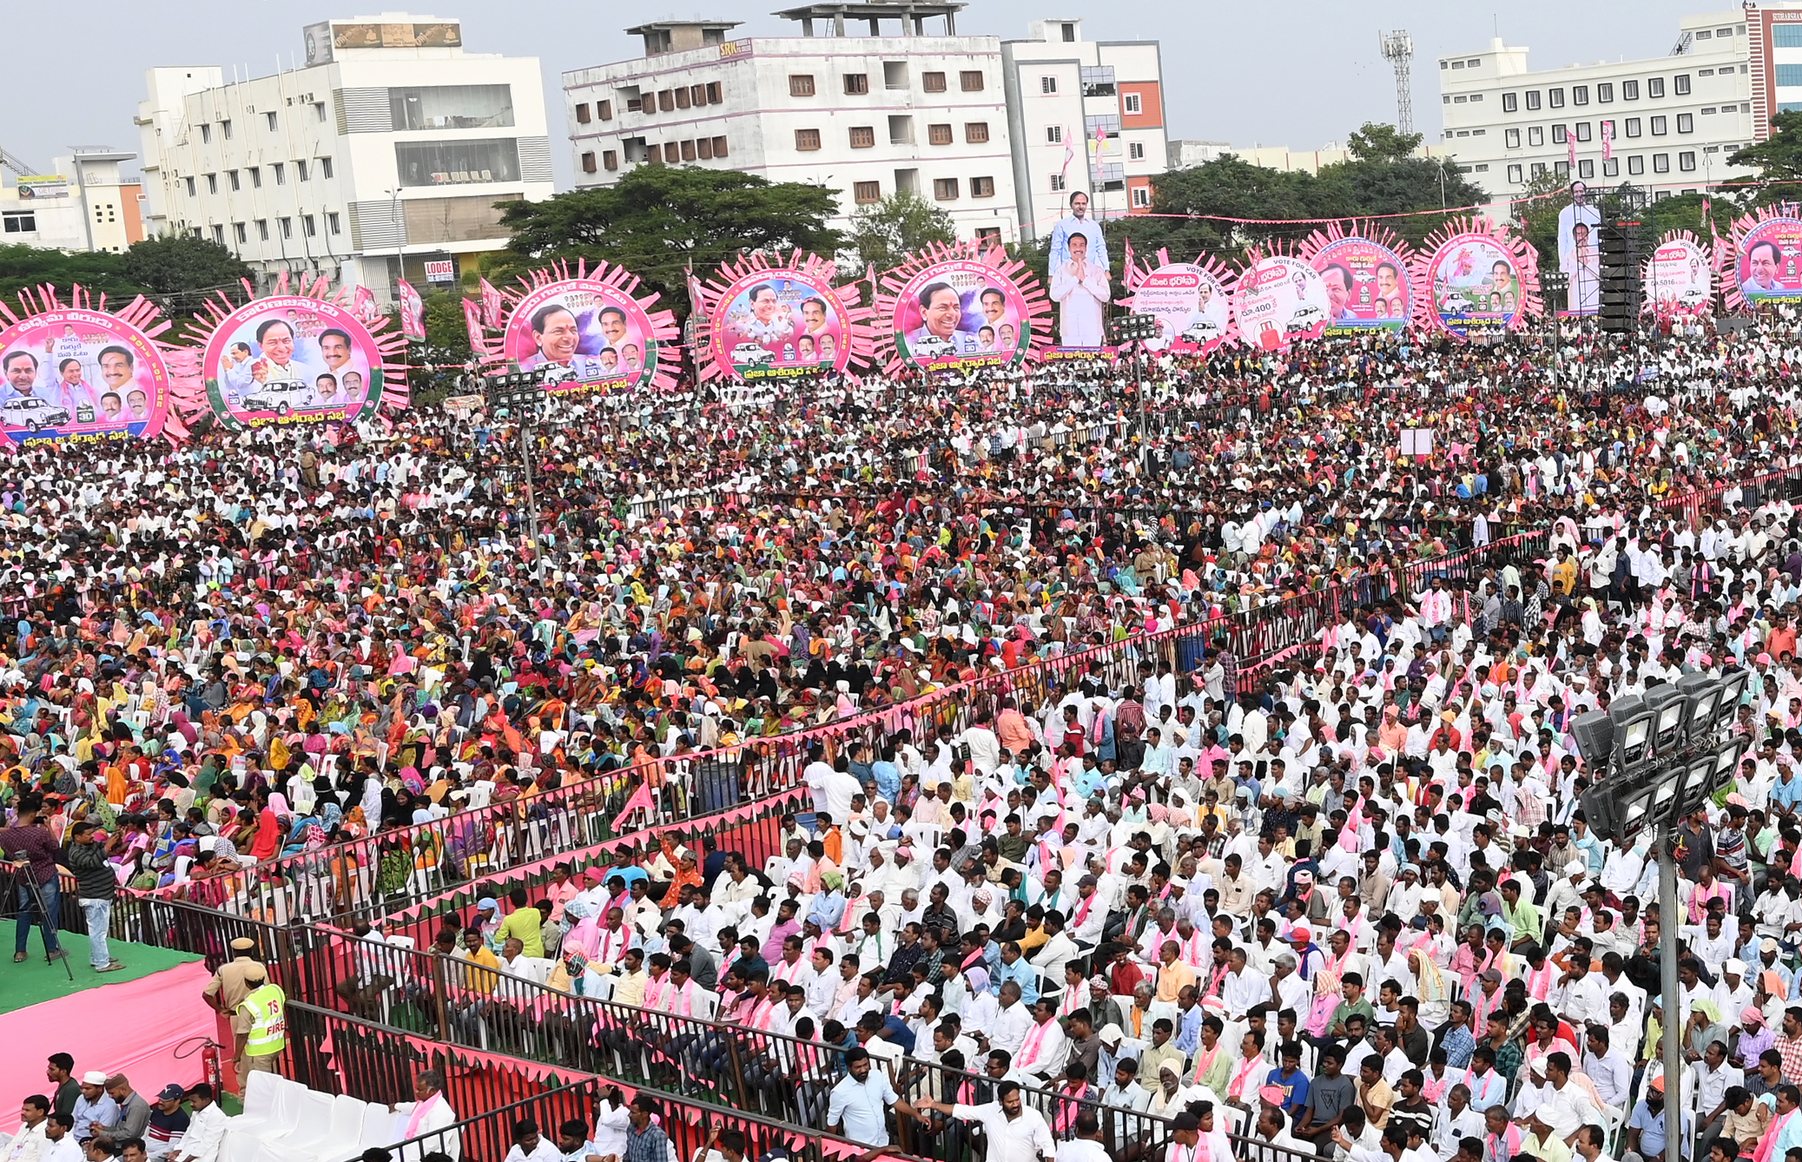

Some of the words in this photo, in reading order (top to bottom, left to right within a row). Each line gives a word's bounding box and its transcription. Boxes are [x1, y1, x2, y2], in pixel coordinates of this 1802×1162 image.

[720, 41, 737, 56] SRK
[426, 262, 452, 274] LODGE
[1291, 260, 1306, 270] FOR
[1305, 268, 1317, 280] CAR
[1186, 266, 1203, 276] VOTE
[1204, 273, 1216, 285] FOR
[1214, 284, 1225, 298] CAR
[399, 285, 411, 324] BRS
[249, 416, 276, 427] ప్రజా
[278, 412, 326, 424] ఆశీర్వాద
[327, 410, 347, 420] సభ
[267, 999, 279, 1016] TS
[266, 1021, 285, 1036] FIRE
